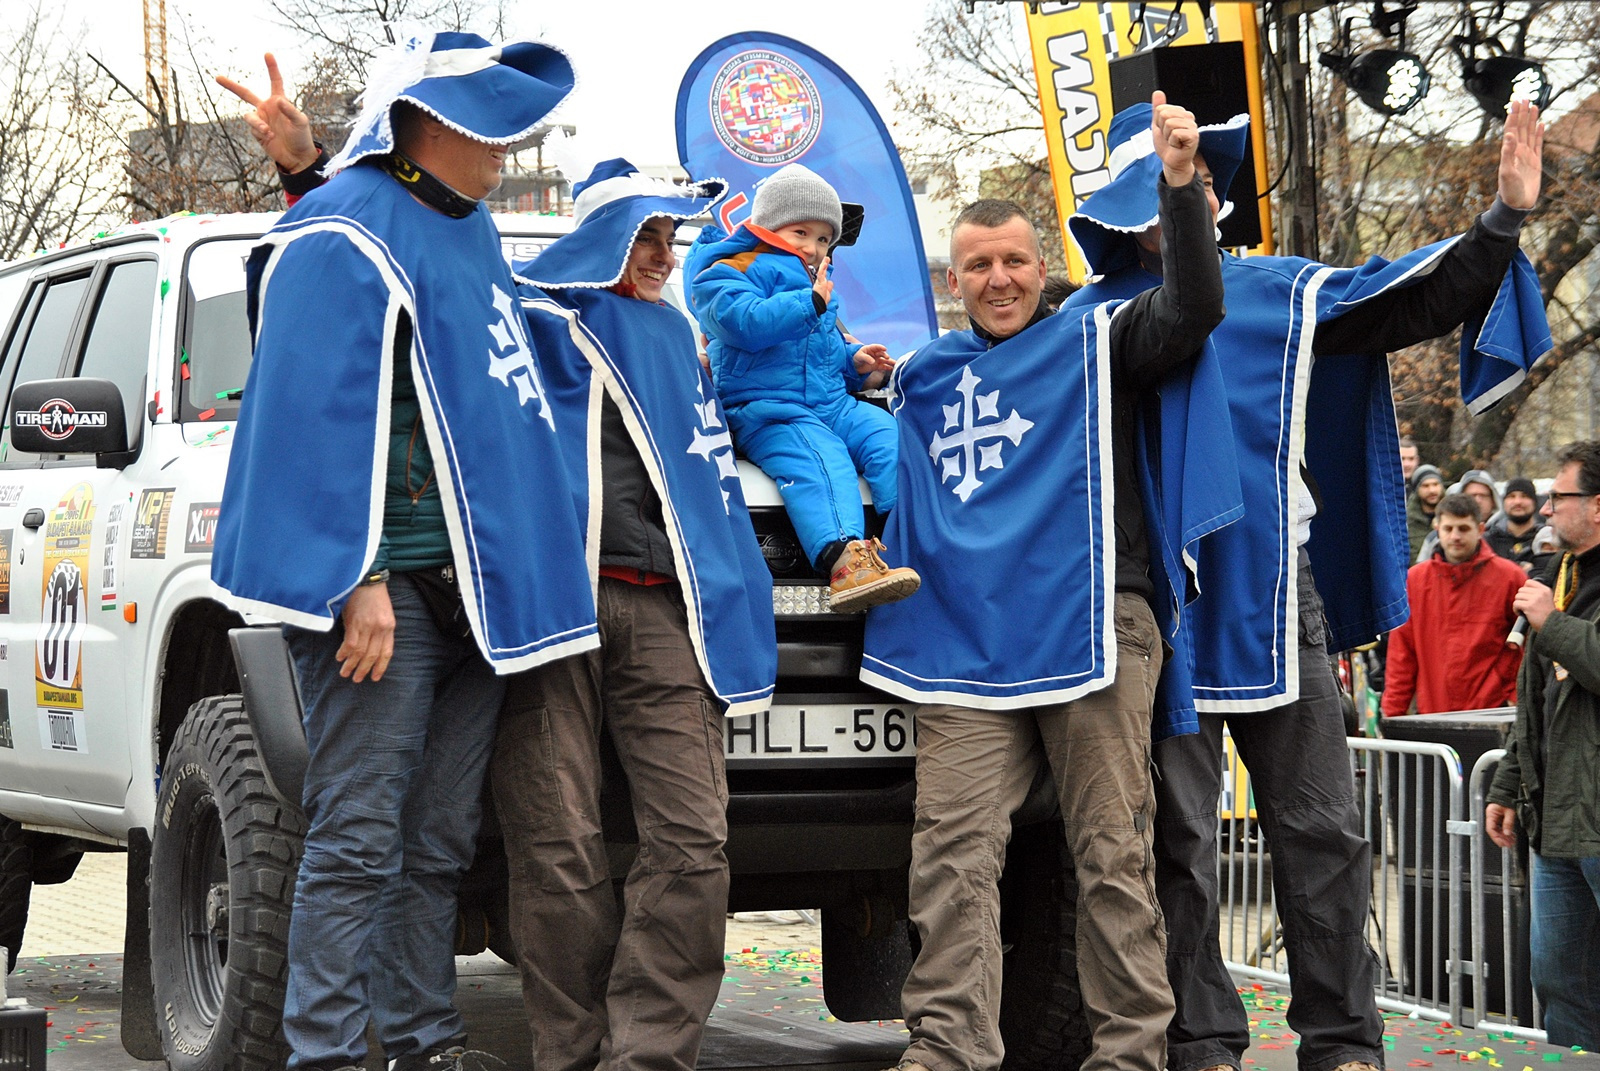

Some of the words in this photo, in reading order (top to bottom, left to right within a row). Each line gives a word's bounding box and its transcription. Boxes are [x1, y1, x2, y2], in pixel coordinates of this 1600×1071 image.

[17, 413, 51, 425] TIRE
[62, 413, 105, 425] MAN
[727, 708, 917, 754] HLL-56
